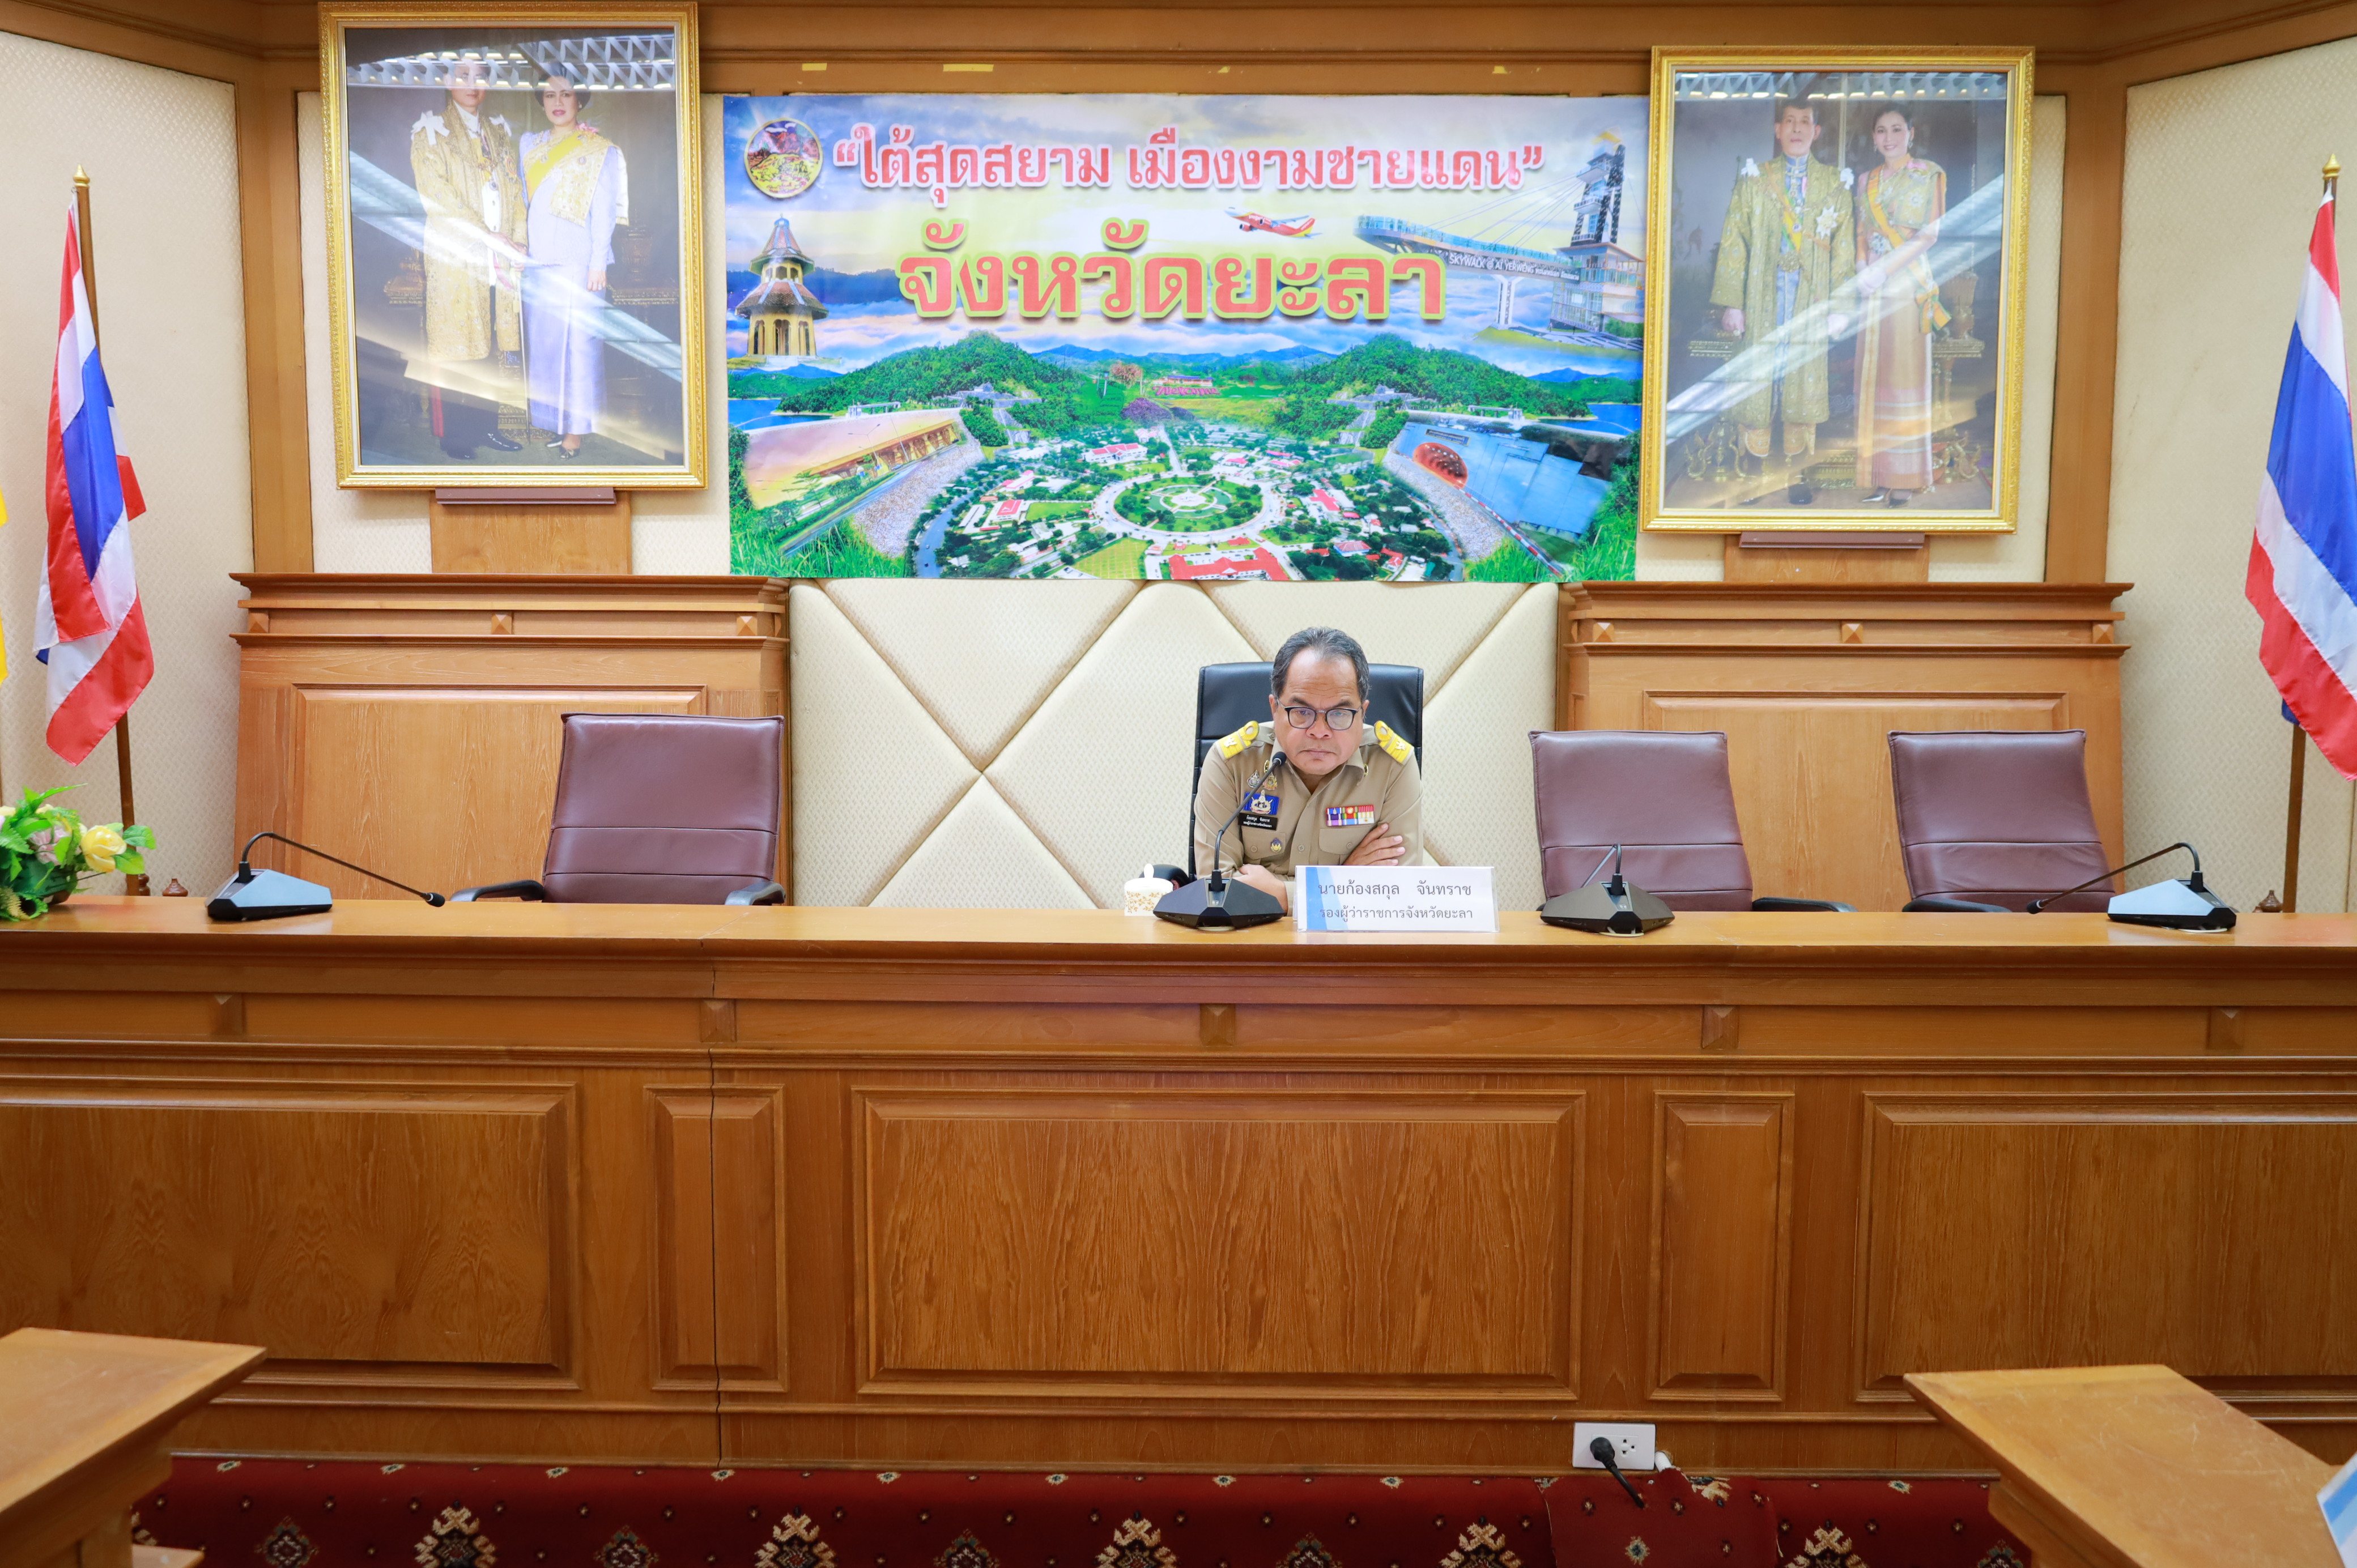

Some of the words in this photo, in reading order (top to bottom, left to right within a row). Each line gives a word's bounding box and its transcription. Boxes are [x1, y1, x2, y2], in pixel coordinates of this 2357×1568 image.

[835, 125, 1109, 203] “ใต้สุดสยาม
[1129, 126, 1543, 187] เมืองงามชายแดน”
[900, 221, 1441, 314] จังหวัดยะลา
[1449, 255, 1485, 269] SKYWALK
[1504, 262, 1534, 274] YERWENG
[1152, 386, 1221, 396] Welcome
[1318, 879, 1399, 900] นายก้องสกุล
[1416, 880, 1471, 895] จันทราช
[1320, 905, 1473, 922] รองผู้ว่าราชการจังหวัดยะลา
